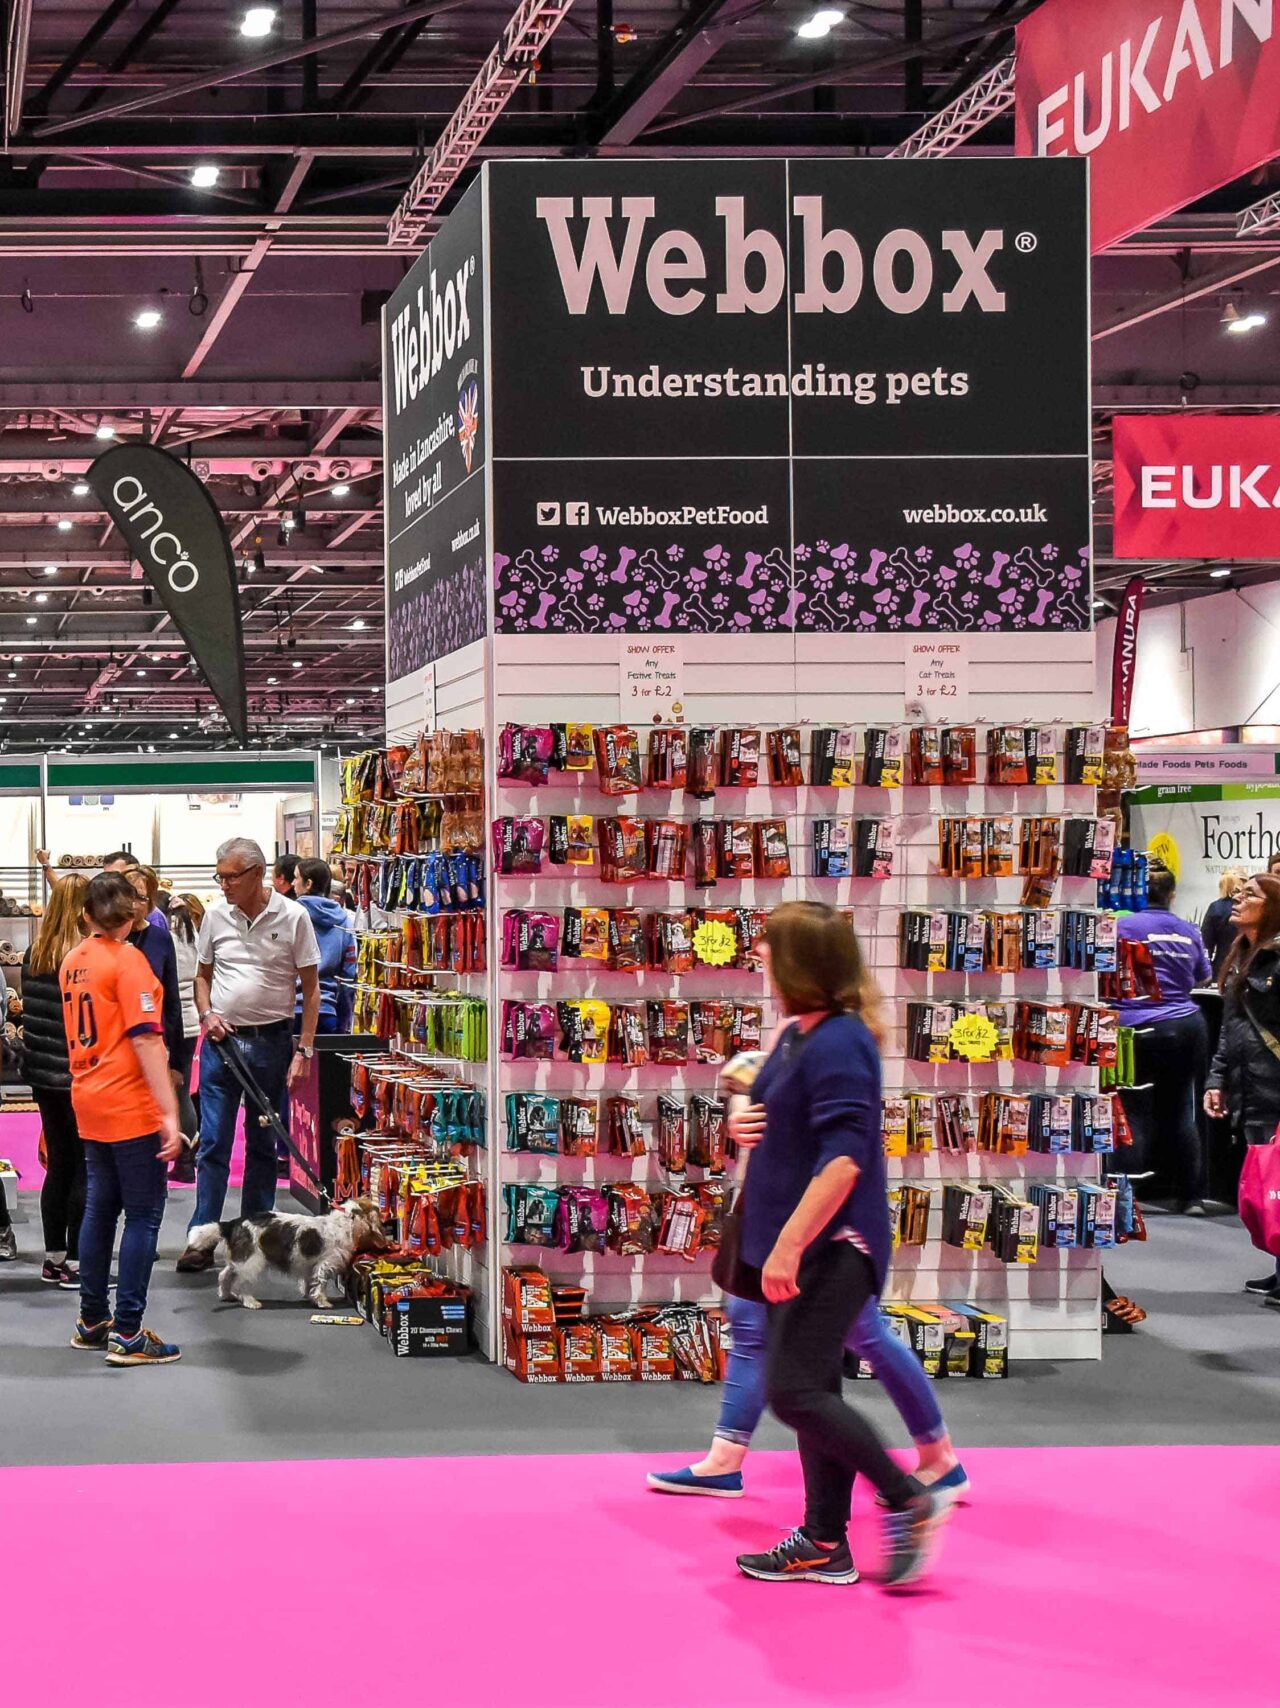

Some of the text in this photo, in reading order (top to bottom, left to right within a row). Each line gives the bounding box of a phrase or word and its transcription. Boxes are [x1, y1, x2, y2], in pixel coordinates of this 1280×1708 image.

[581, 363, 969, 404] Understanding pets
[392, 452, 410, 489] Made
[405, 478, 421, 518] loved
[1141, 465, 1280, 508] EUK
[596, 505, 769, 525] WebboxPetFood
[902, 504, 1048, 524] webbox.co.uk
[112, 476, 199, 592] anco
[627, 645, 676, 654] SHOW OFFER
[912, 645, 961, 654] SHOW OFFER
[627, 671, 677, 680] Festive Treats
[645, 659, 659, 668] Any
[918, 670, 956, 679] Cat Treats
[930, 659, 944, 668] Any
[632, 685, 672, 697] 3 for £2
[917, 685, 958, 697] 3 for £2
[731, 732, 740, 758] Webbox
[827, 732, 837, 757] Webbox
[875, 732, 885, 758] Webbox
[1028, 730, 1038, 756] Webbox
[1076, 731, 1085, 756] Webbox
[1137, 760, 1248, 769] lade Foods Pets Foods
[504, 825, 514, 853] Webbox
[616, 831, 624, 858] Webbox
[724, 825, 732, 851] Webbox
[821, 822, 829, 848] Webbox
[868, 823, 878, 849] Webbox
[1084, 822, 1095, 848] Webbox
[519, 923, 528, 950] Webbox
[572, 919, 581, 944] Webbox
[699, 936, 707, 946] 3
[742, 921, 750, 947] Webbox
[922, 918, 930, 944] Webbox
[958, 919, 967, 944] Webbox
[1027, 916, 1035, 942] Webbox
[1086, 919, 1095, 944] Webbox
[517, 1011, 525, 1040] Webbox
[733, 1009, 742, 1034] Webbox
[923, 1010, 932, 1035] Webbox
[954, 1028, 964, 1039] 3
[1077, 1010, 1087, 1034] Webbox
[1089, 1012, 1099, 1038] Webbox
[518, 1108, 526, 1134] Webbox
[1041, 1100, 1051, 1126] Webbox
[1083, 1100, 1091, 1126] Webbox
[517, 1201, 526, 1227] Webbox
[570, 1206, 579, 1233] Webbox
[959, 1194, 970, 1220] Webbox
[1048, 1195, 1057, 1220] Webbox
[1010, 1208, 1020, 1234] Webbox
[397, 1312, 410, 1356] Webbox
[521, 1323, 552, 1333] Webbox
[978, 1324, 986, 1349] Webbox
[527, 1374, 557, 1383] Webbox
[564, 1373, 595, 1383] Webbox
[602, 1372, 631, 1381] Webbox
[641, 1372, 671, 1381] Webbox
